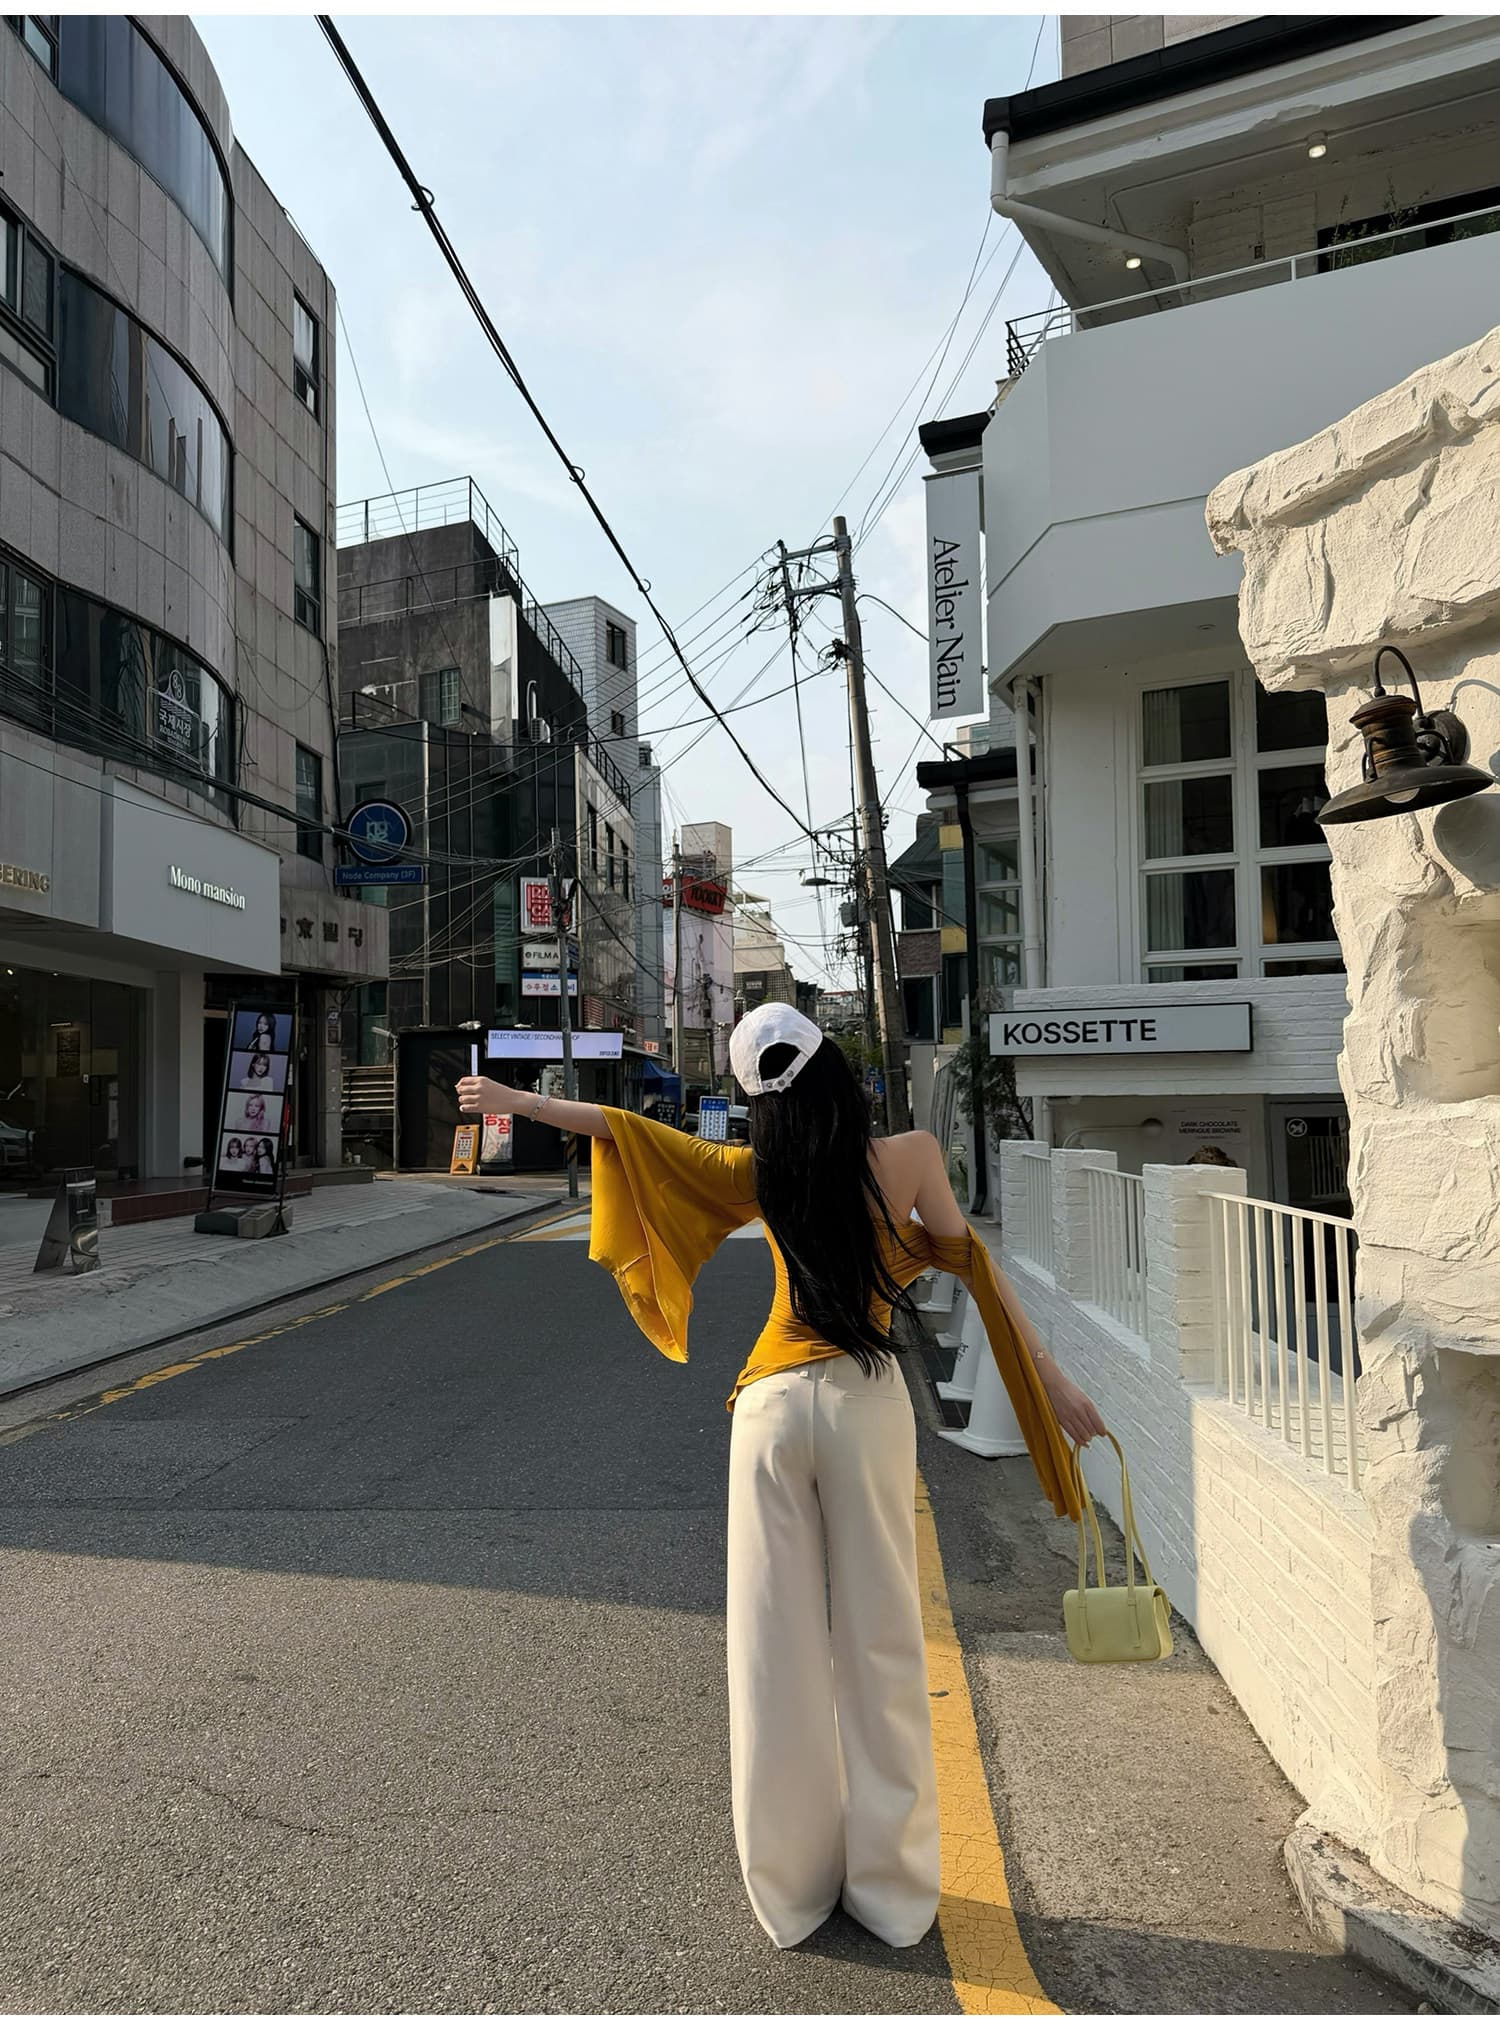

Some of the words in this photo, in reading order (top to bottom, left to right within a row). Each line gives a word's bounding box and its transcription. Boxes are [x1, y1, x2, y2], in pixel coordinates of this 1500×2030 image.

[933, 536, 969, 630] Atelier
[936, 632, 965, 711] Nain
[158, 708, 192, 738] 국제시장
[169, 864, 201, 894] Mono
[203, 883, 246, 910] mansion
[342, 871, 362, 880] Node
[364, 870, 399, 881] Company
[510, 1033, 530, 1041] VINTAGE
[1003, 1019, 1157, 1046] KOSSETTE
